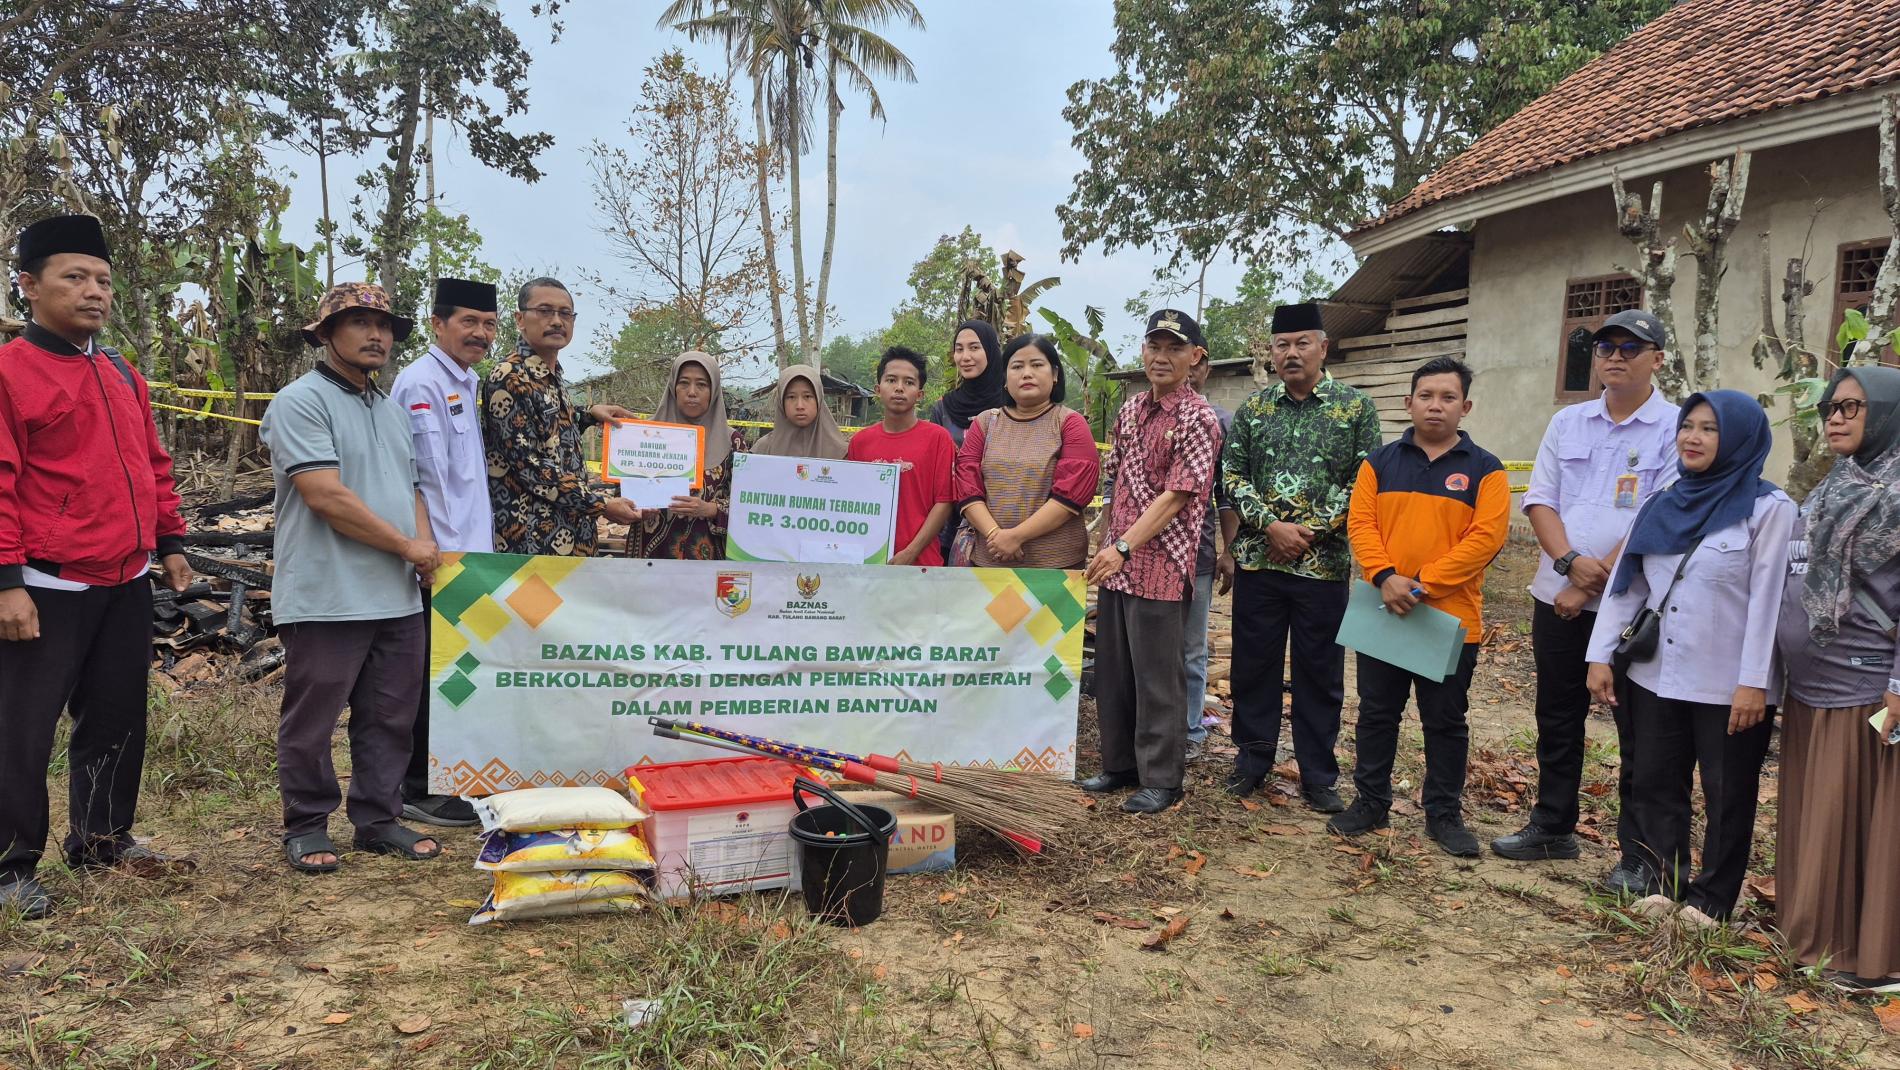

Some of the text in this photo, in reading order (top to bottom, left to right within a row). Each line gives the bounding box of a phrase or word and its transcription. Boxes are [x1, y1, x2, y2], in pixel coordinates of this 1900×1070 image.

[640, 441, 667, 450] BANTUAN
[639, 461, 684, 471] 1.000.000
[739, 490, 881, 516] BANTUAN RUMAH TERBAKAR
[747, 511, 869, 535] RP. 3.000.000
[786, 601, 828, 609] BAZNAS
[541, 644, 1000, 662] BAZNAS KAB. TULANG BAWANG BARAT
[495, 671, 1032, 688] BERKOLABORASI DENGAN PEMERINTAH DAERAH
[611, 698, 938, 716] DALAM PEMBERIAN BANTUAN
